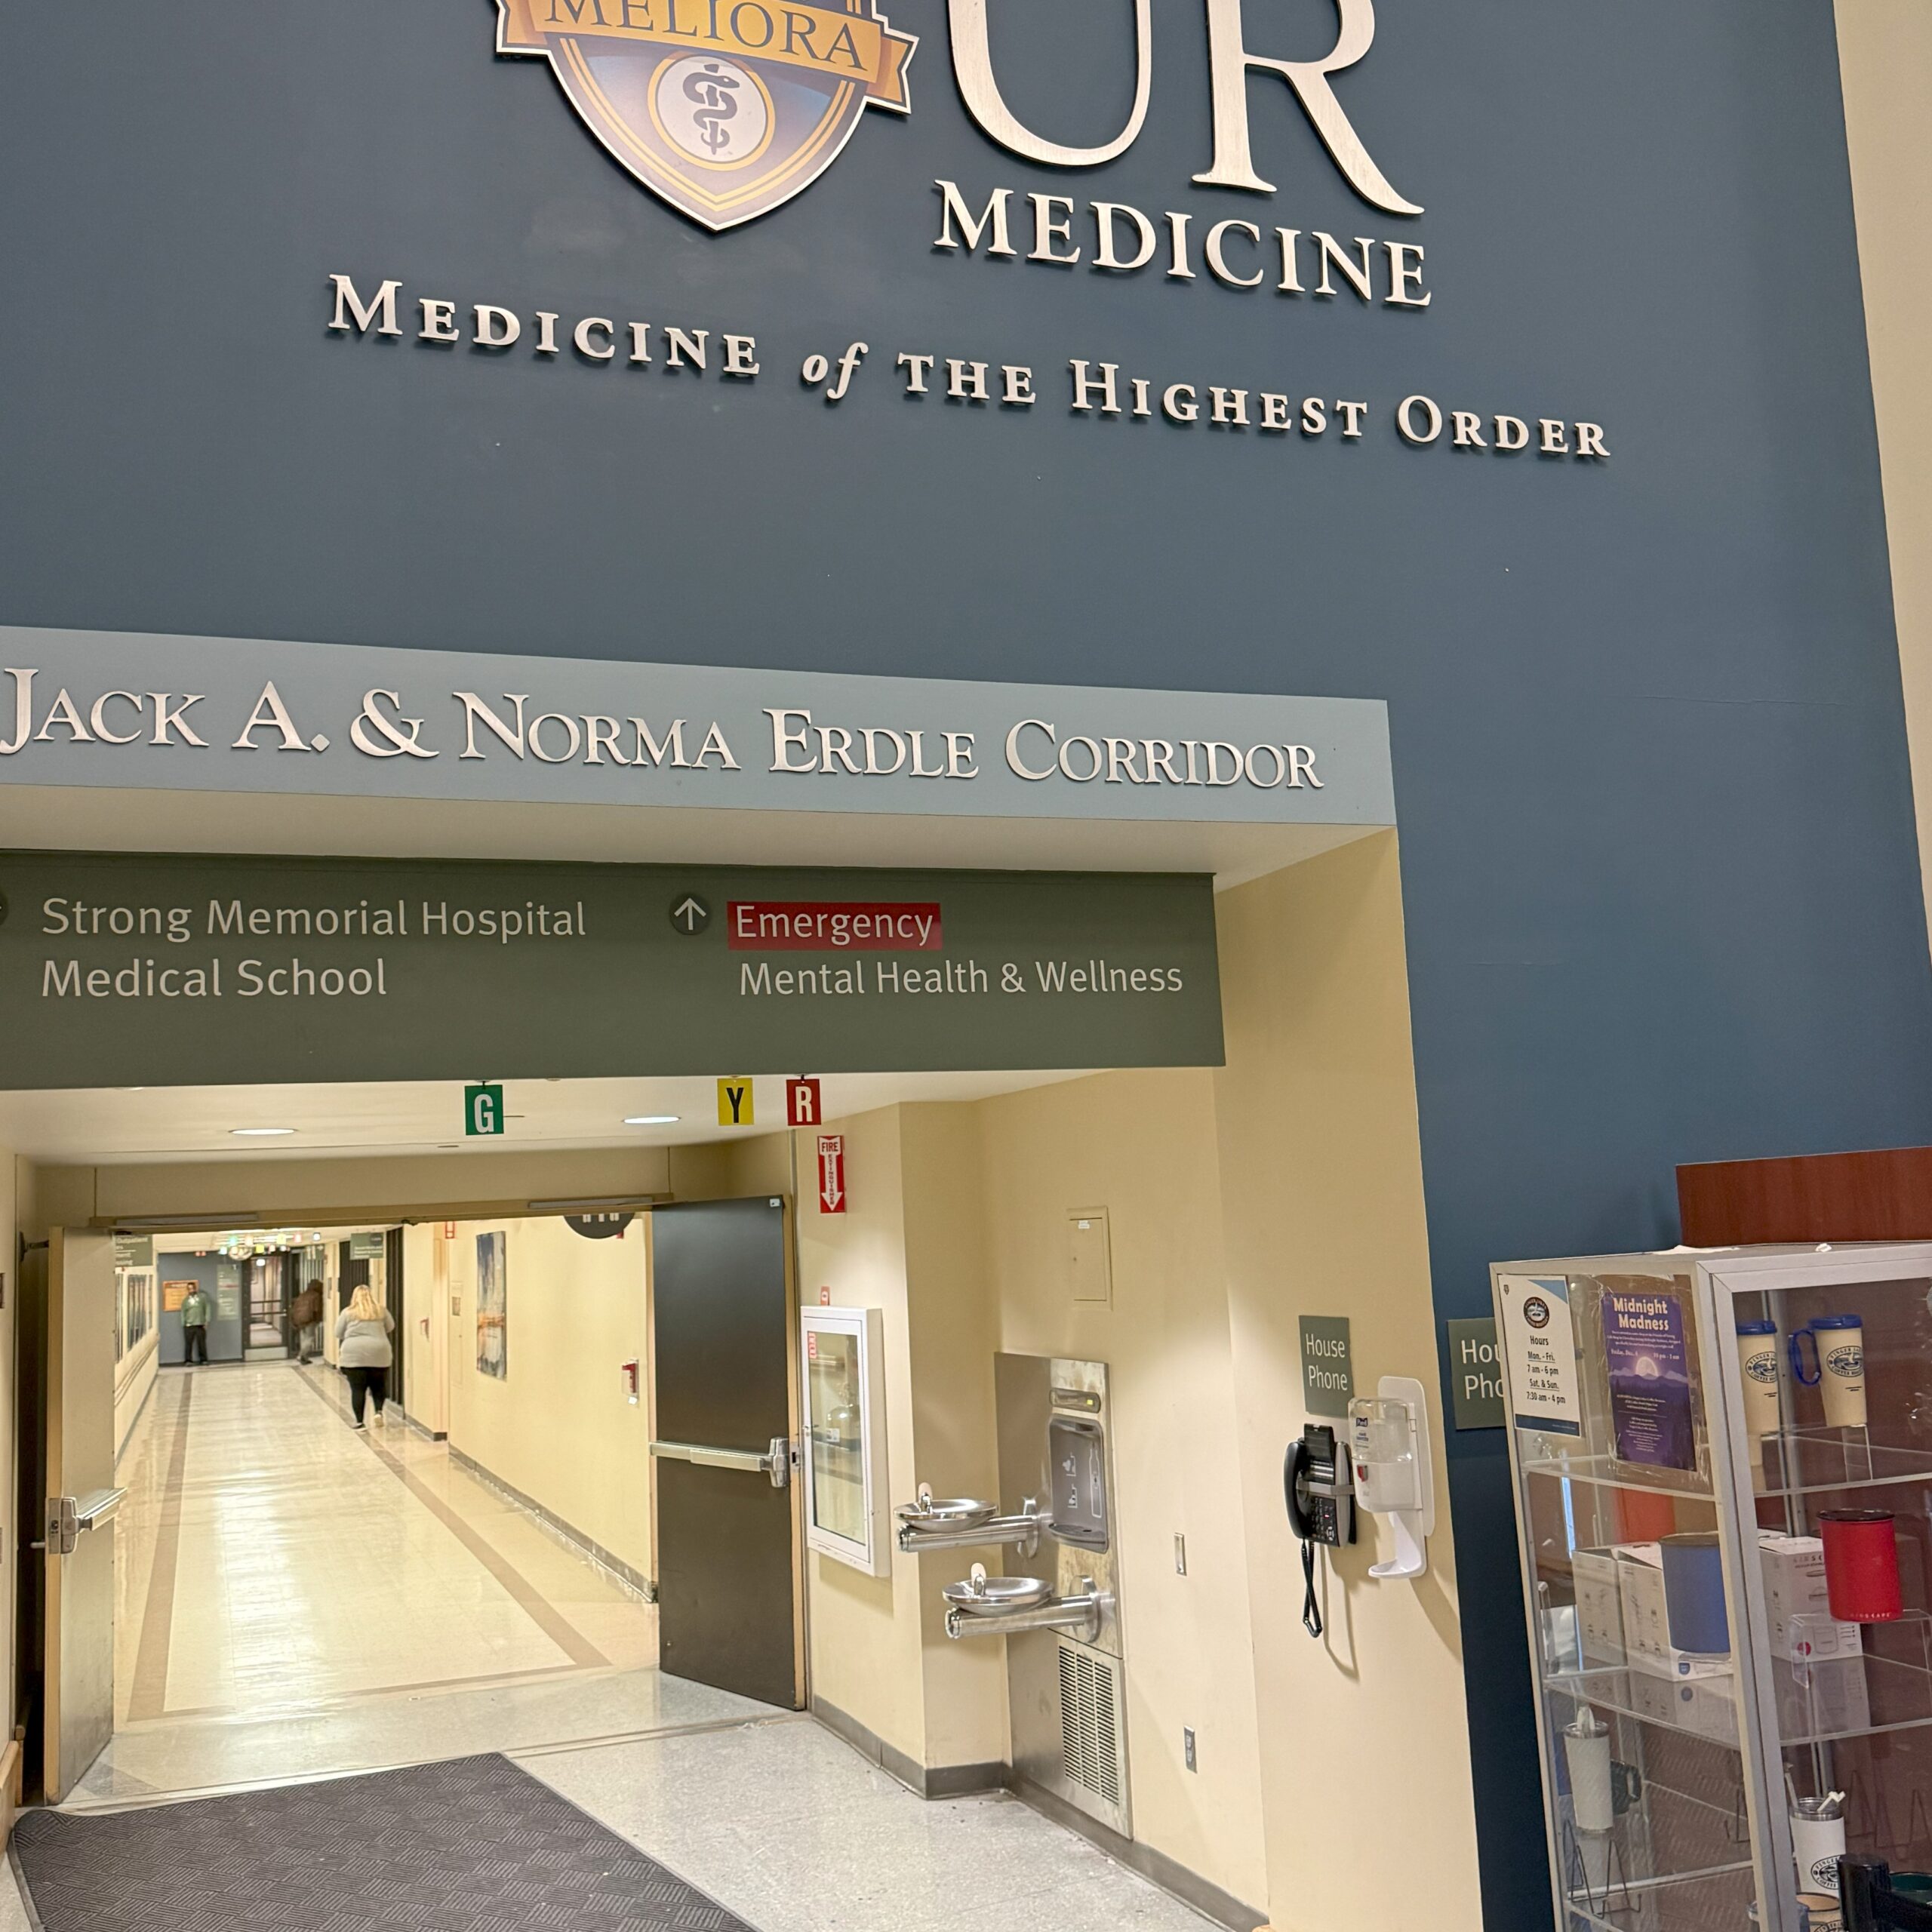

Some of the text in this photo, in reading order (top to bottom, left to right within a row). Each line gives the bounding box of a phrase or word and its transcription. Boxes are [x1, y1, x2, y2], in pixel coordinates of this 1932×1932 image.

[947, 0, 1426, 215] UR
[934, 179, 1432, 307] MEDICINE
[328, 273, 1612, 458] MEDICINE of THE HIGHEST ORDER
[0, 667, 1326, 790] JACK A. & NORMA ERDLE CORRIDOR
[42, 897, 586, 944] Strong Memorial Hospital
[734, 904, 935, 947] Emergency
[42, 958, 387, 998] Medical School
[740, 960, 1183, 997] Mental Health & Wellness
[473, 1094, 494, 1134] G
[725, 1087, 745, 1124] Y
[795, 1085, 814, 1123] R
[821, 1142, 839, 1152] FIRE
[1613, 1297, 1668, 1316] Midnight
[1618, 1313, 1669, 1331] Madness
[1305, 1333, 1346, 1358] House
[1527, 1351, 1541, 1360] Mon.
[1546, 1352, 1555, 1361] Fri.
[1530, 1335, 1549, 1346] Hours
[1308, 1364, 1348, 1391] Phone
[1527, 1364, 1531, 1373] 7
[1544, 1365, 1549, 1374] 6
[1549, 1367, 1559, 1377] pm
[1529, 1378, 1559, 1389] Sat. & Sun.
[1526, 1391, 1537, 1401] 7:30
[1556, 1396, 1566, 1405] pm
